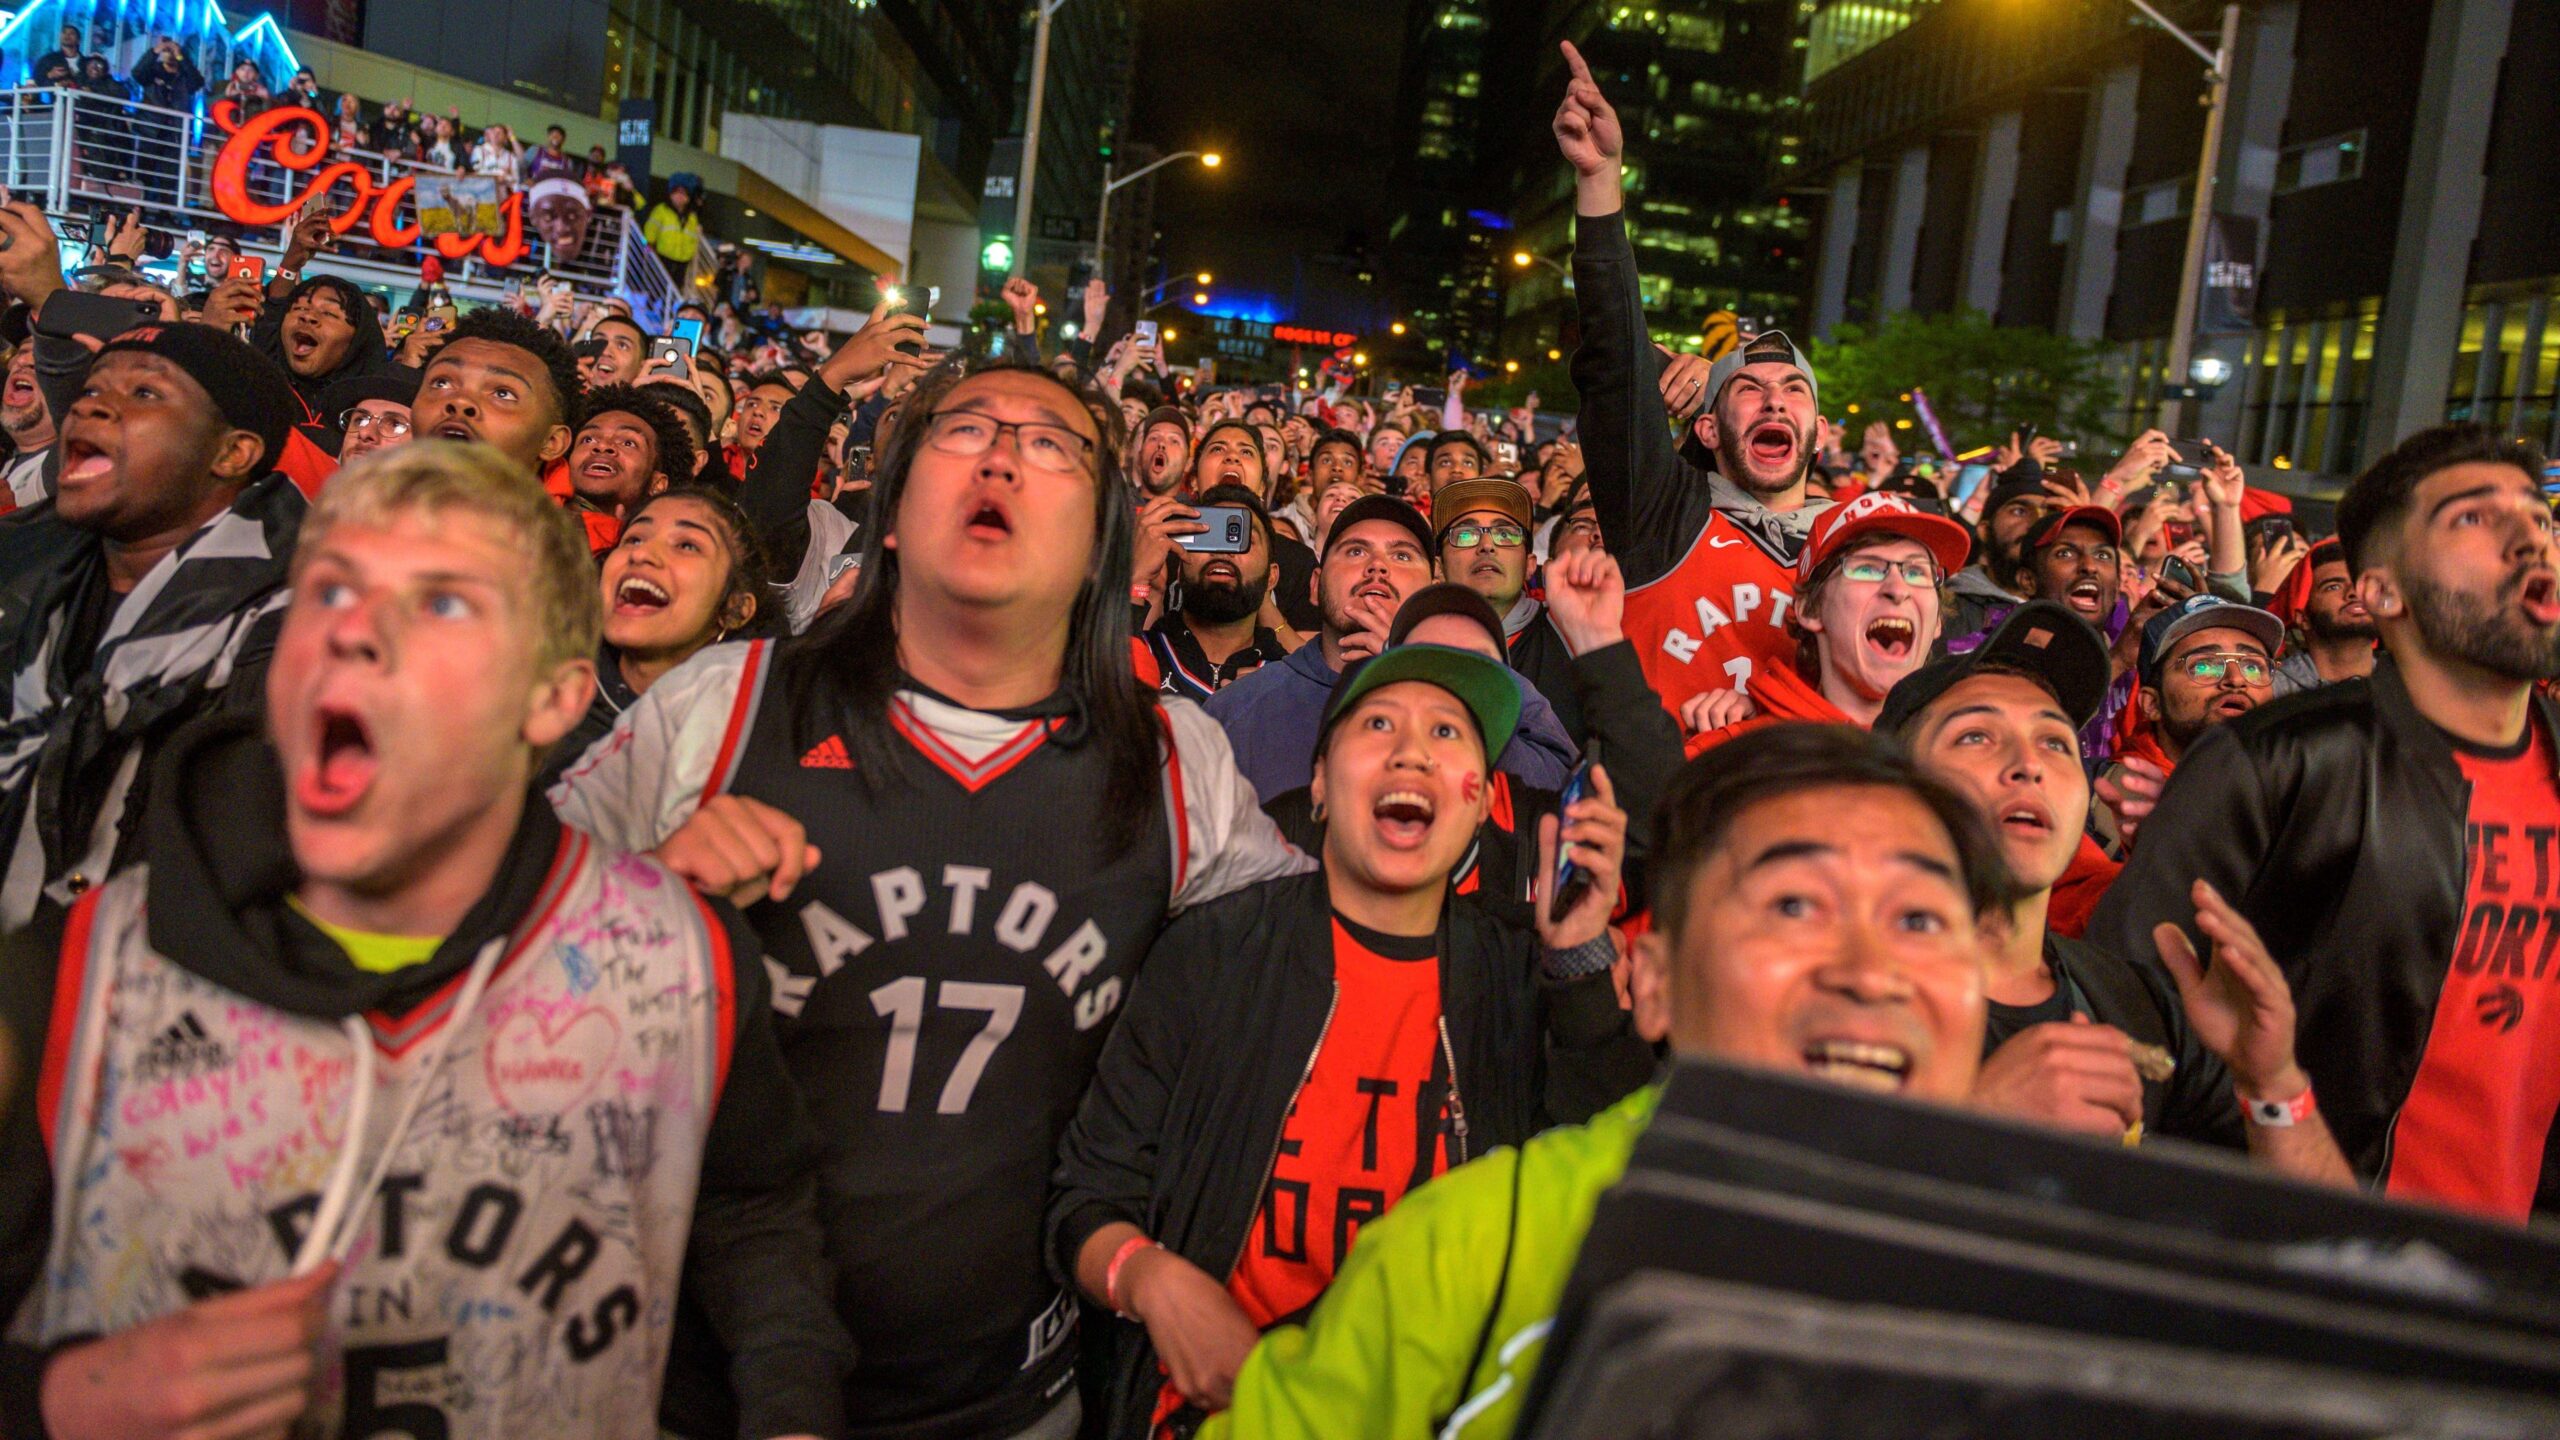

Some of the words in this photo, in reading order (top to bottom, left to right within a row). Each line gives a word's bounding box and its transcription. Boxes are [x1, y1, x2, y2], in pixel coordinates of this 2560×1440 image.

[211, 99, 531, 268] Coos
[619, 132, 650, 146] NORTH
[1662, 582, 1793, 665] RAPT
[761, 863, 1123, 1032] RAPTORS
[868, 975, 1027, 1115] 17
